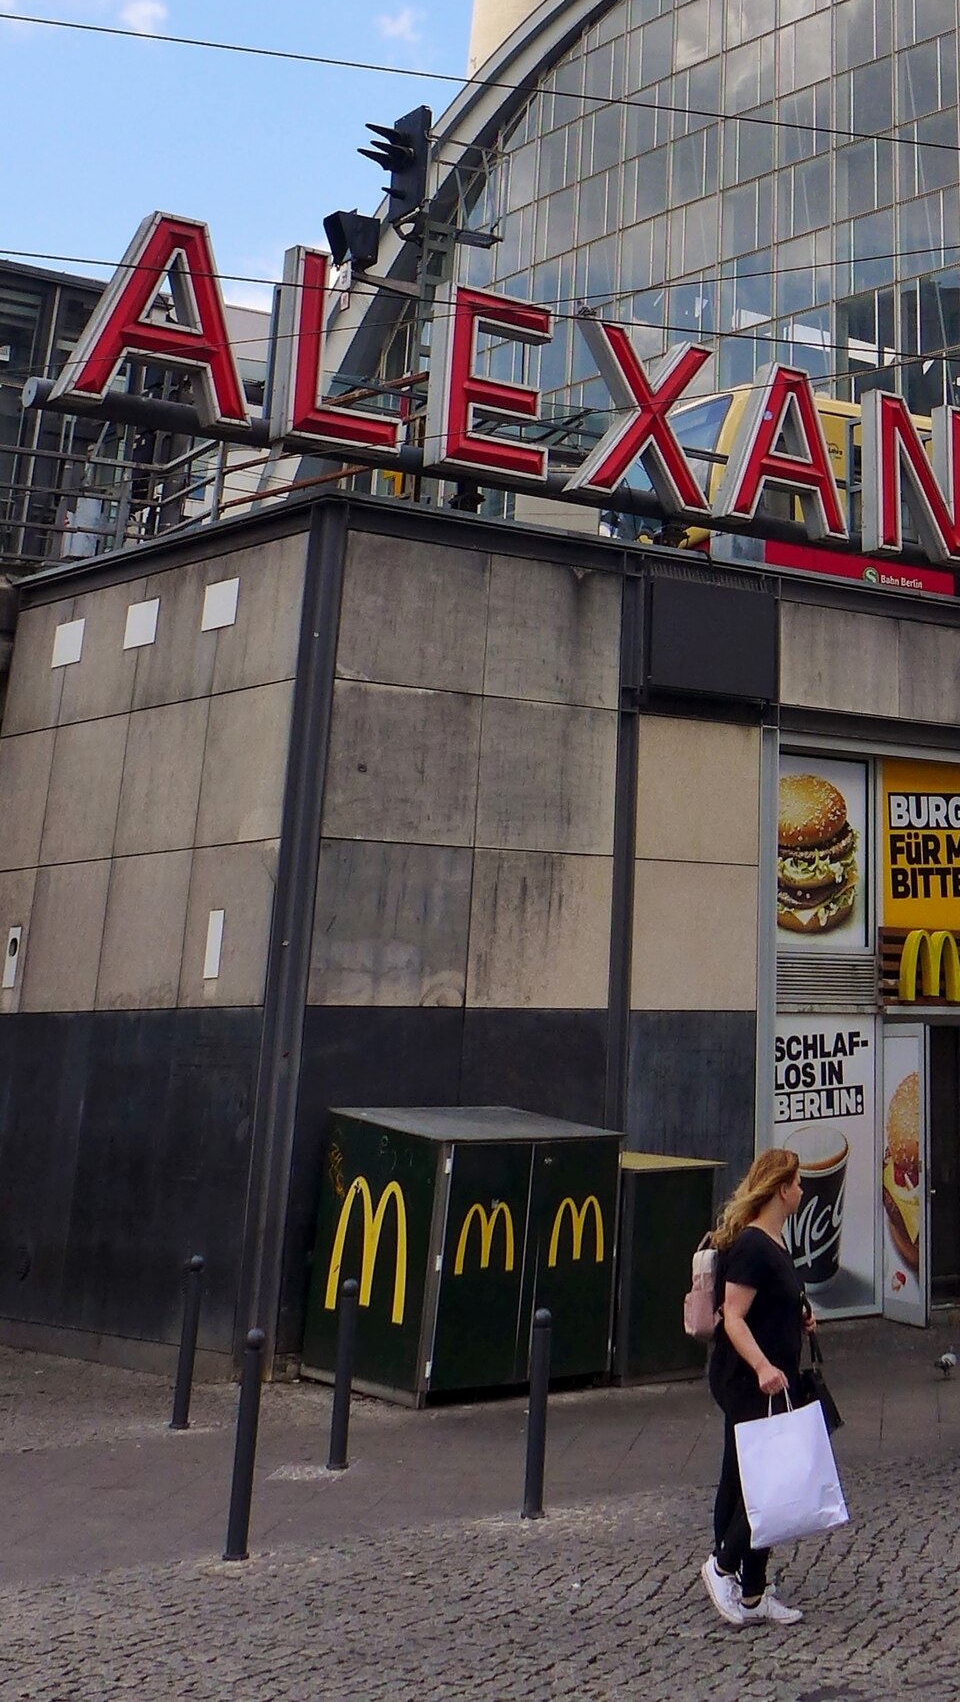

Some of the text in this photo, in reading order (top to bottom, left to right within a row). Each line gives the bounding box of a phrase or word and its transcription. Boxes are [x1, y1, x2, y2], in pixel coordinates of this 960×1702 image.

[880, 574, 900, 587] Bahn
[900, 577, 923, 589] Berlin
[774, 1031, 869, 1063] SCHLAF-
[774, 1060, 844, 1091] LOS IN
[774, 1087, 863, 1122] BERLIN:
